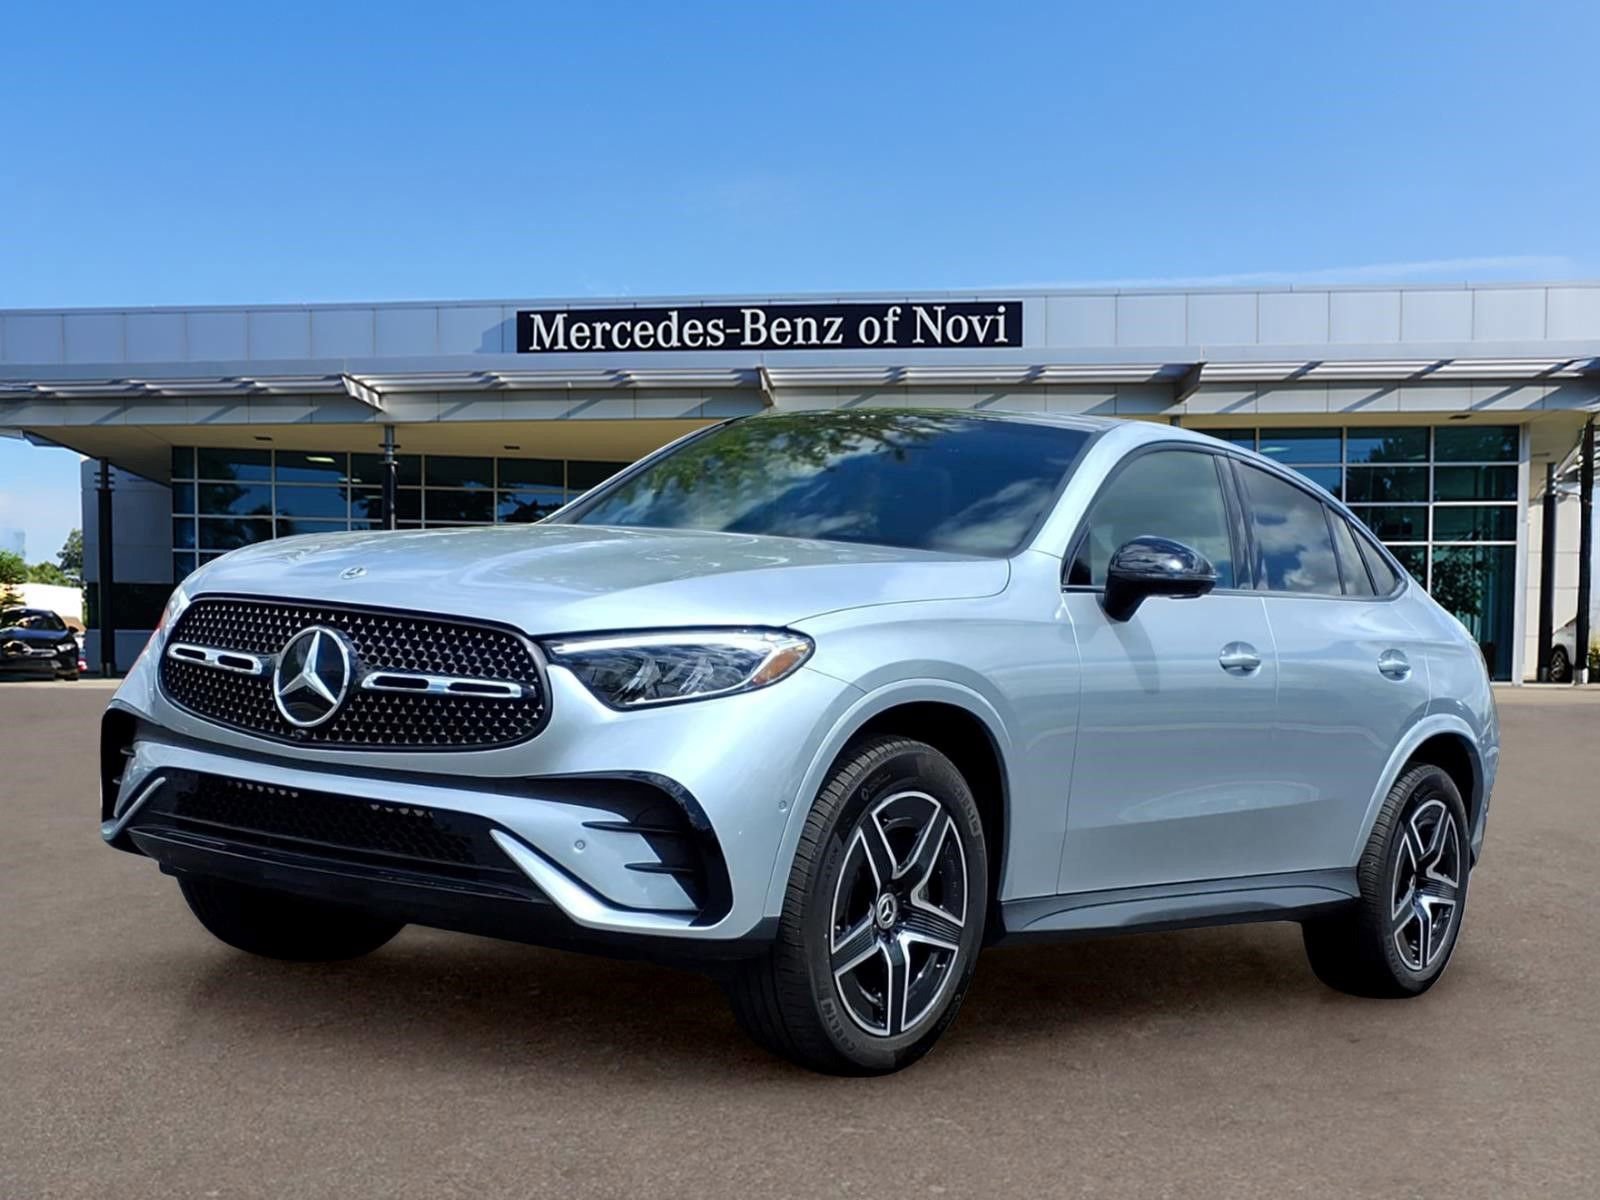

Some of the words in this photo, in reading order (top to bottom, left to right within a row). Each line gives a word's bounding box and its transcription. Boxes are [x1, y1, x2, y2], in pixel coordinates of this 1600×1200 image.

[529, 308, 844, 350] Mercedes-Benz
[858, 306, 901, 345] of
[912, 305, 1009, 344] Novi
